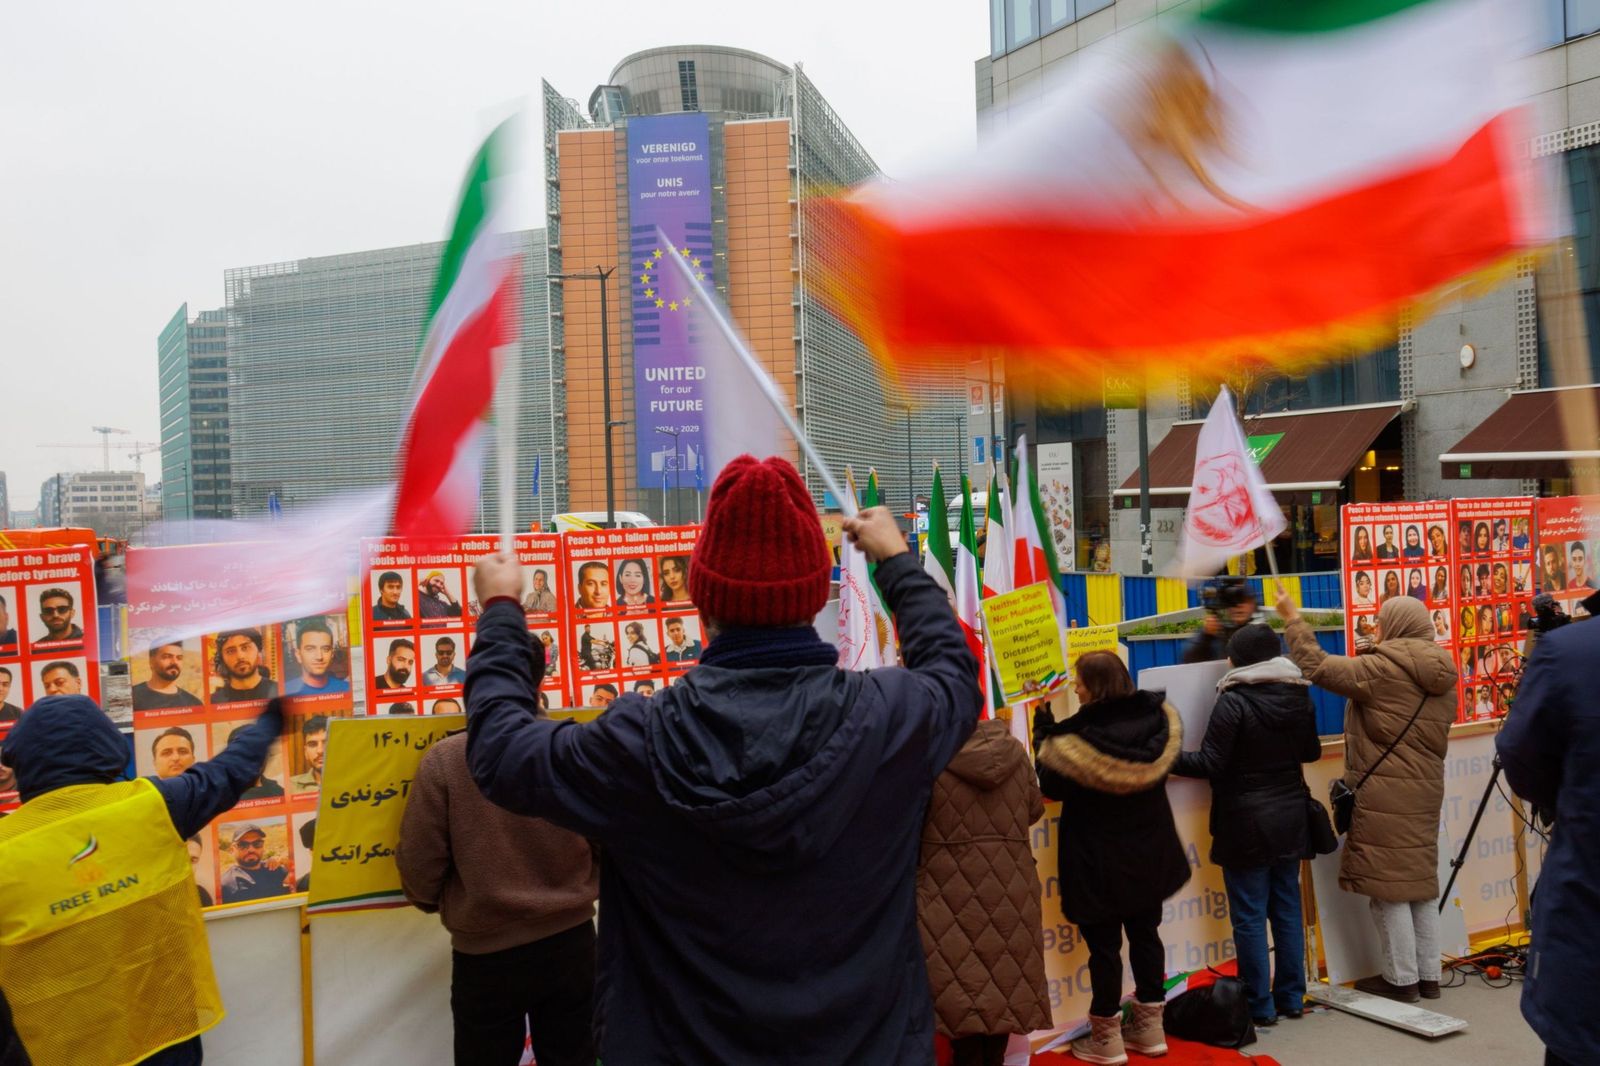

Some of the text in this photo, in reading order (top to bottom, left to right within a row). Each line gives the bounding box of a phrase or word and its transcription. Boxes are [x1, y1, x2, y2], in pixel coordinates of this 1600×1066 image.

[641, 142, 696, 154] VERENIGD
[671, 154, 703, 162] toekomst
[657, 177, 683, 188] UNIS
[658, 190, 677, 198] notre
[678, 188, 700, 196] avenir
[645, 366, 706, 382] UNITED
[660, 384, 693, 394] for our
[650, 399, 703, 412] FUTURE
[680, 425, 700, 433] 2029
[1157, 520, 1174, 533] 232
[567, 535, 594, 545] Peace
[597, 535, 606, 544] to
[609, 534, 622, 543] the
[625, 532, 649, 543] fallen
[652, 531, 678, 541] rebels
[681, 529, 696, 539] and
[461, 540, 490, 550] rebels
[531, 539, 556, 549] brave
[570, 547, 593, 557] souls
[594, 547, 612, 556] who
[613, 544, 644, 555] refused
[645, 545, 654, 553] to
[655, 542, 677, 552] kneel
[23, 554, 43, 566] the
[47, 553, 81, 564] brave
[396, 555, 415, 565] who
[453, 553, 462, 563] to
[0, 567, 80, 582] efore tyranny.
[992, 614, 1008, 624] Nor
[992, 613, 1051, 637] Iranian People
[1012, 629, 1039, 644] Reject
[1003, 638, 1054, 659] Dictatorship
[1014, 652, 1048, 669] Demand
[1016, 664, 1052, 681] Freedom
[49, 873, 139, 916] FREE IRAN
